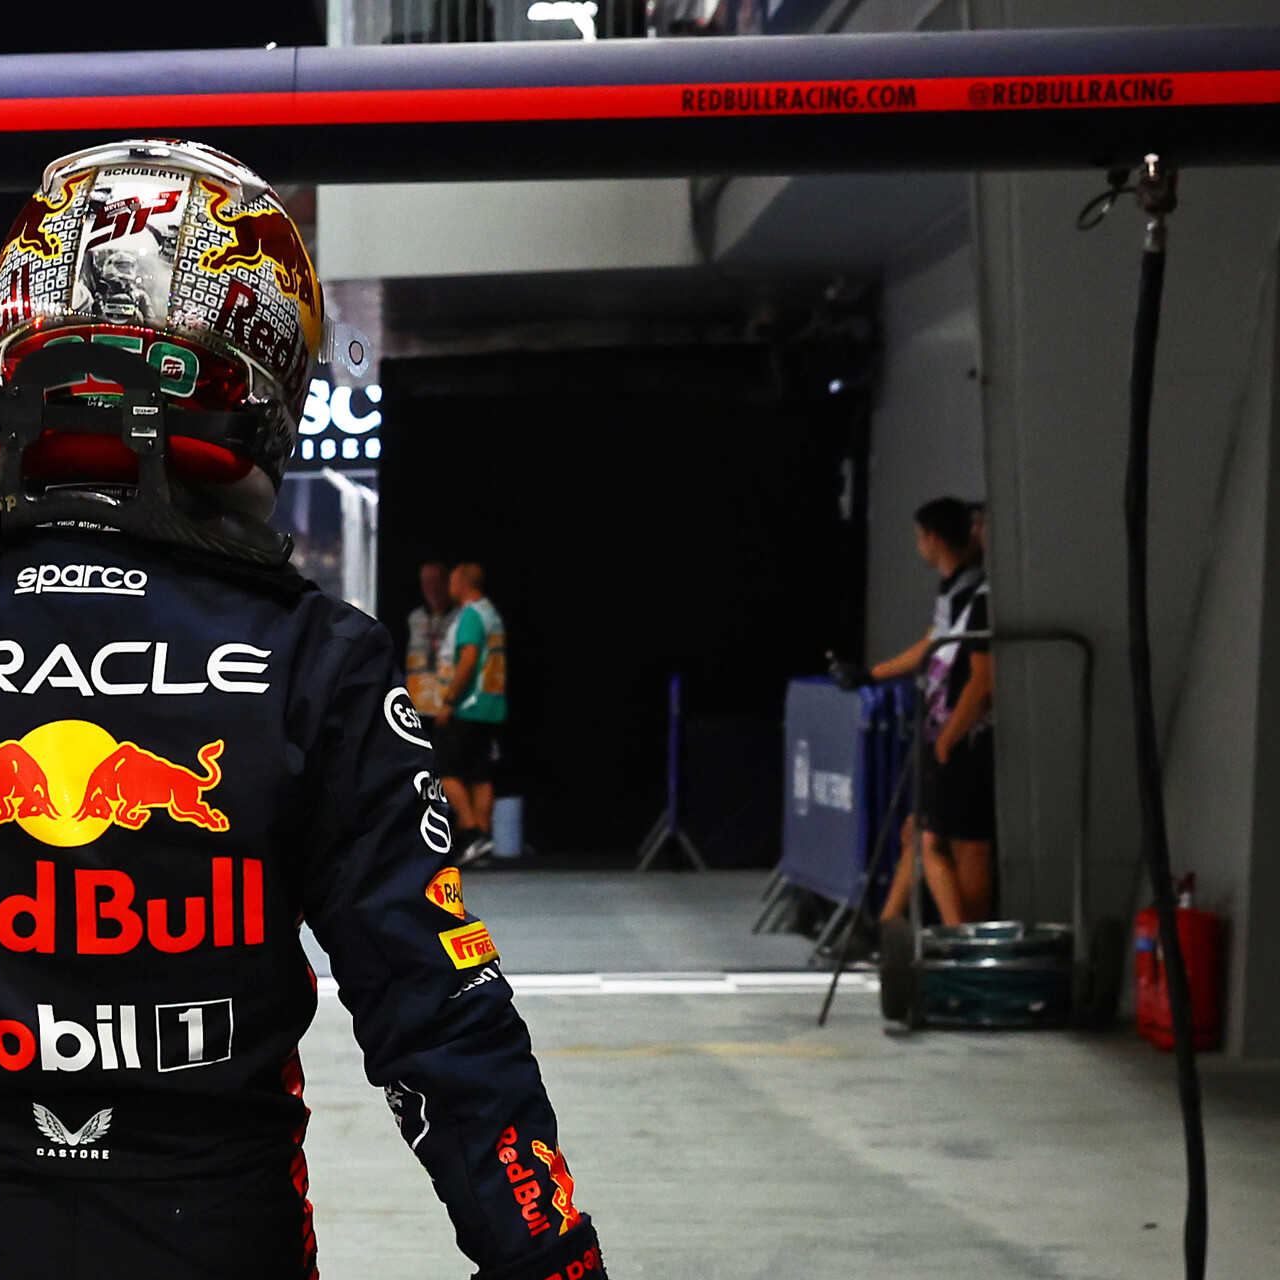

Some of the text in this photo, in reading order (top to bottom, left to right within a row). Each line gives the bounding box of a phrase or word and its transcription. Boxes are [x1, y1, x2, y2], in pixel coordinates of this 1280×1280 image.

[681, 79, 1174, 111] REDBULLRACING.COM @REDBULLRACING
[104, 168, 185, 181] SCHUBERTH
[14, 564, 148, 595] sparco
[74, 856, 265, 955] Bull
[36, 1147, 111, 1160] CASTORE
[496, 1125, 551, 1238] Red Bull
